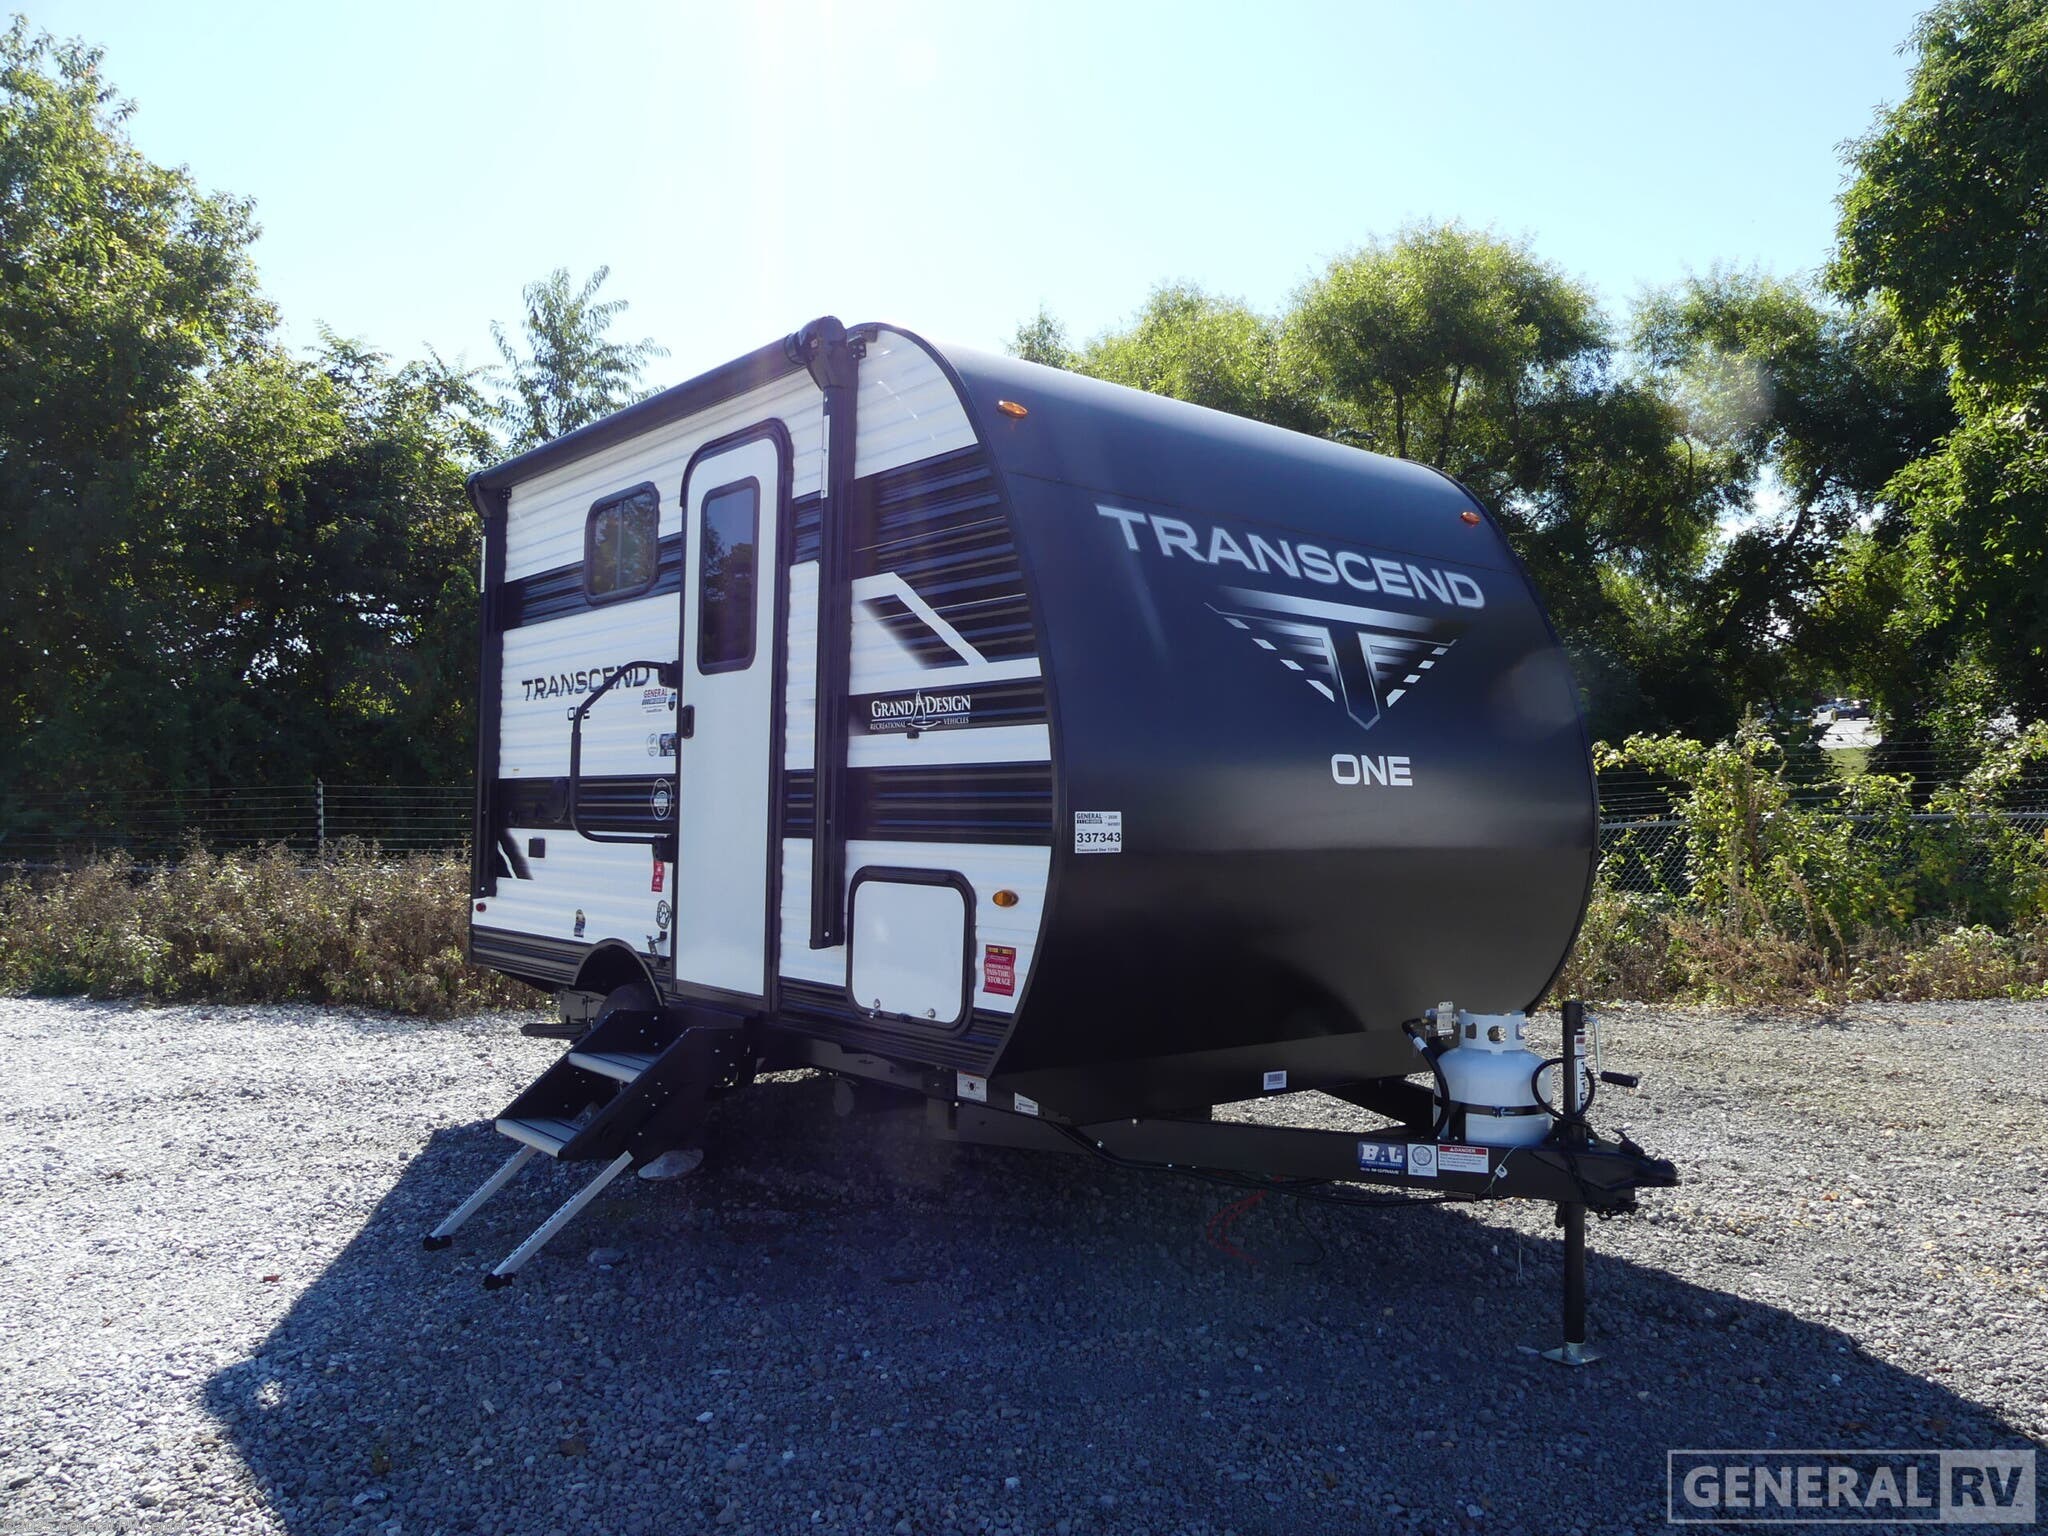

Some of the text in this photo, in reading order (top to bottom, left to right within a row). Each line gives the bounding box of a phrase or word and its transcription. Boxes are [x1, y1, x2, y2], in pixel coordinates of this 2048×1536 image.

[1096, 504, 1485, 609] TRANSCEND
[522, 665, 650, 701] TRANSCEND
[871, 694, 971, 718] GRAND DESIGN
[870, 716, 969, 730] RECREATIONAL VEHICLES
[1331, 753, 1413, 787] ONE
[1076, 812, 1102, 820] GENERAL
[1076, 832, 1121, 844] 337343
